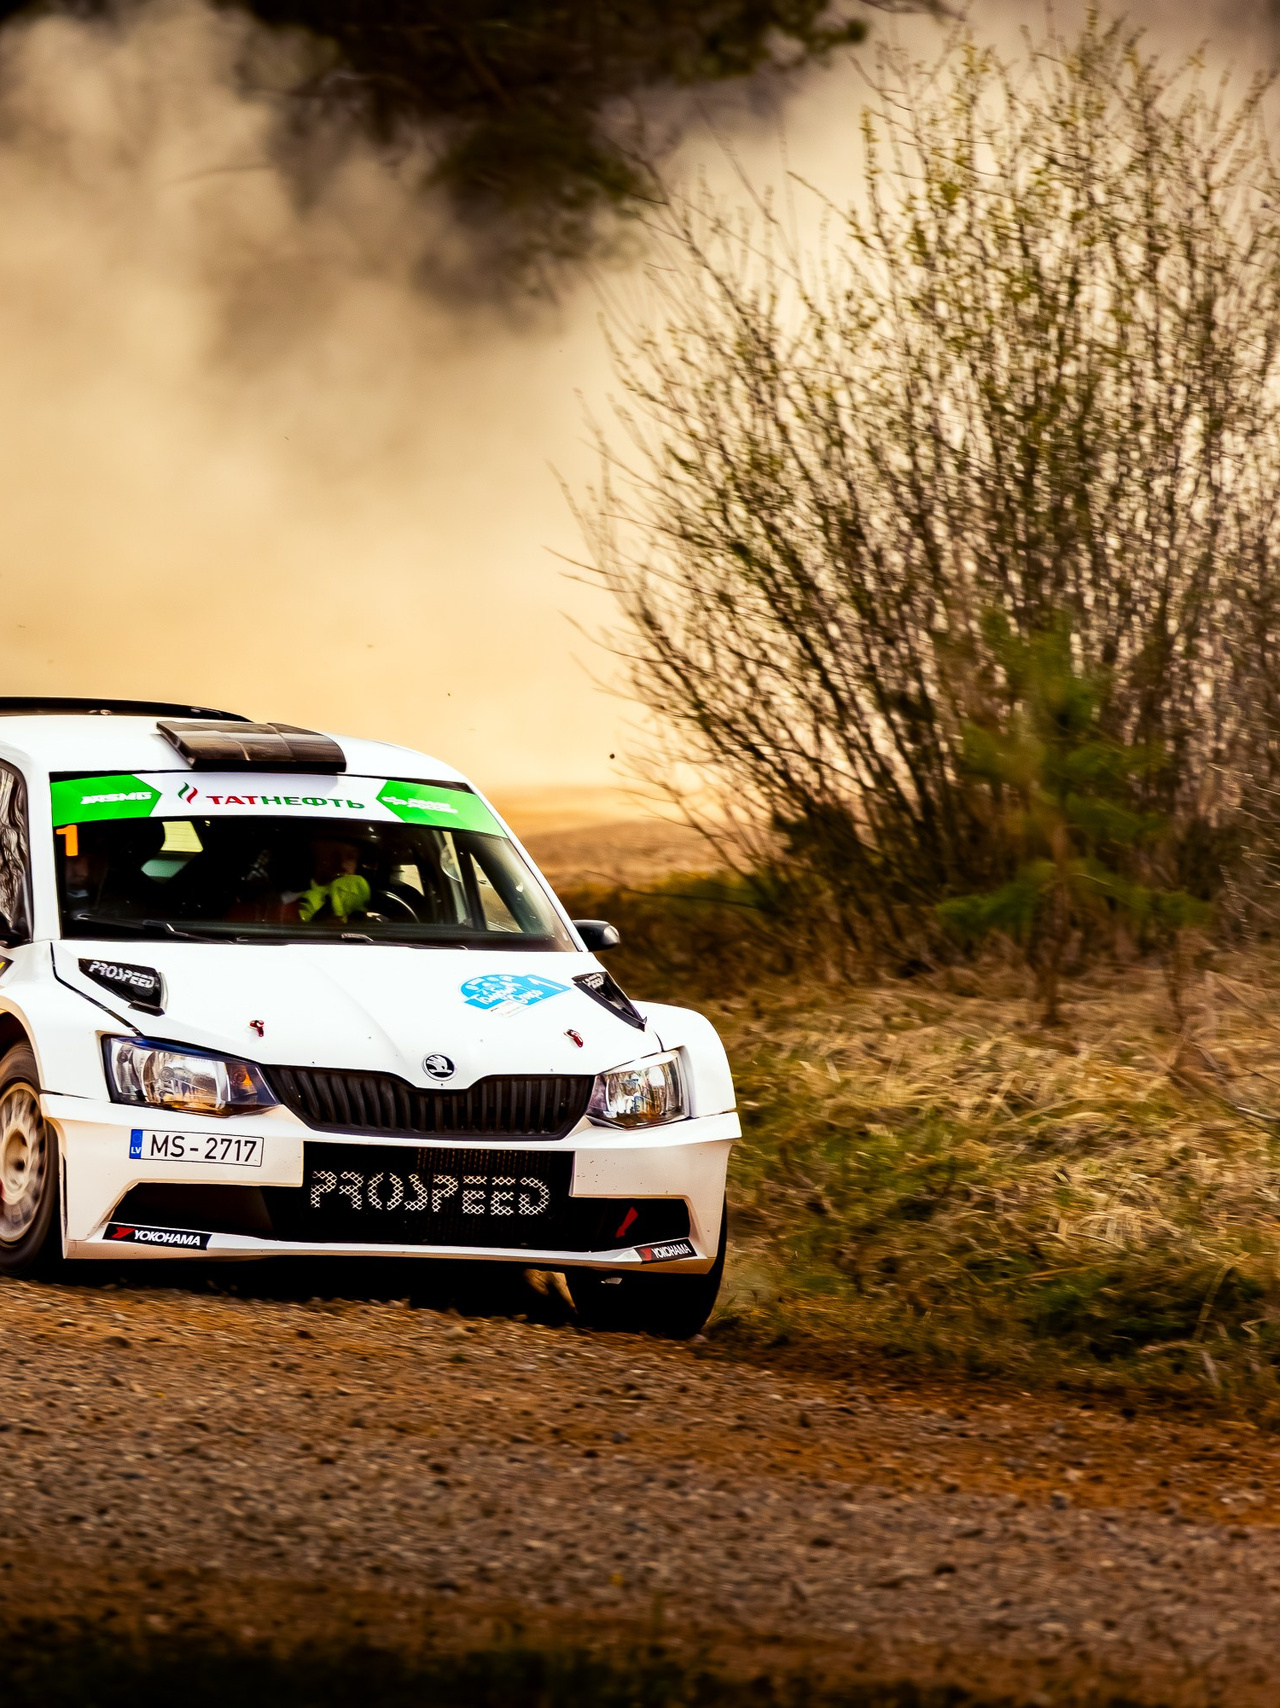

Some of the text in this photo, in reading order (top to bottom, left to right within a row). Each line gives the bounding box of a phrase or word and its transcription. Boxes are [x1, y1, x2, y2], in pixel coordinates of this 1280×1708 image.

[206, 795, 365, 809] ТАТНЕФТЬ
[56, 824, 79, 857] 1
[88, 961, 155, 989] PROSPEED
[130, 1146, 142, 1154] LV
[150, 1133, 258, 1163] MS-2717
[310, 1171, 551, 1216] PROSPEED
[134, 1229, 201, 1246] YOKOHAMA
[651, 1243, 692, 1259] YOKOHAMA
